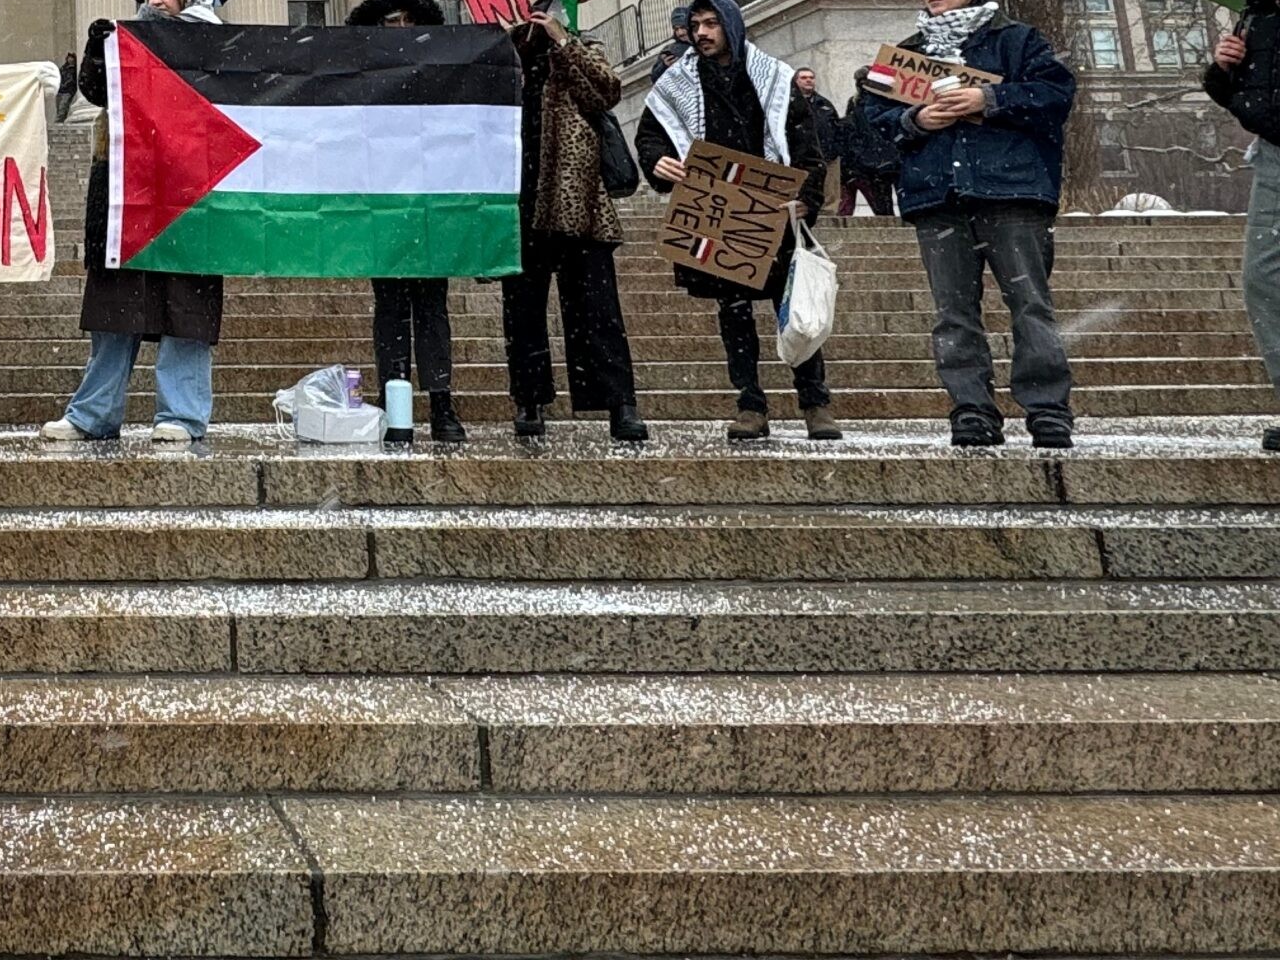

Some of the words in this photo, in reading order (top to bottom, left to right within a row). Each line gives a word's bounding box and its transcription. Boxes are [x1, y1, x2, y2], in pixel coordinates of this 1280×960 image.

[889, 52, 952, 77] HANDS
[663, 154, 723, 250] YEMEN
[705, 194, 728, 230] OFF
[714, 167, 796, 280] HANDS
